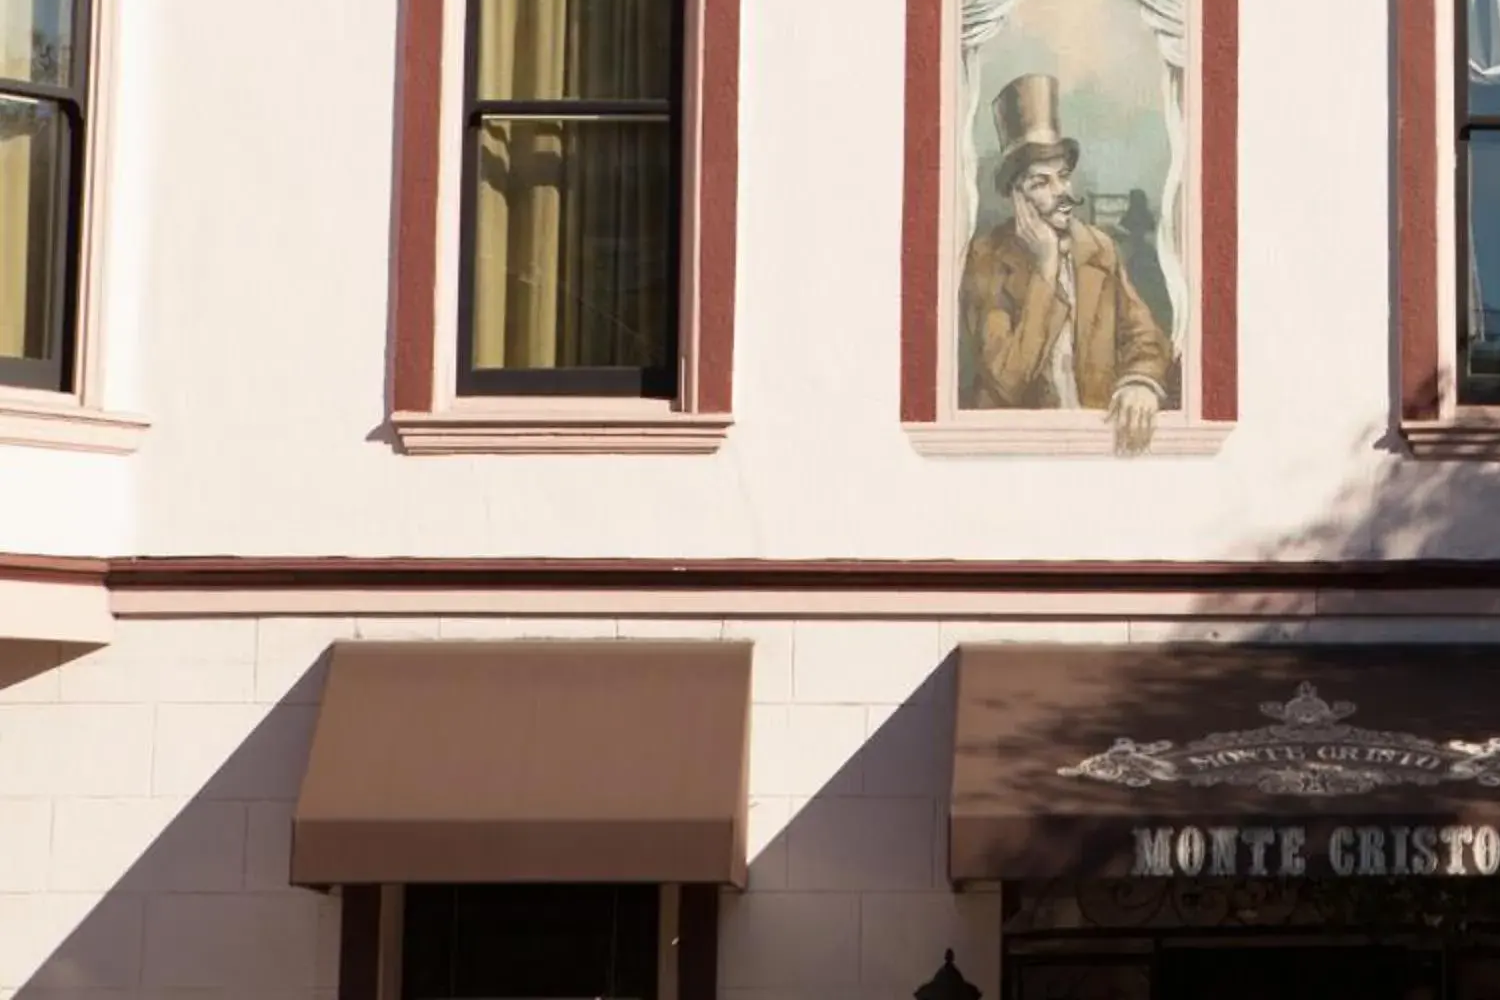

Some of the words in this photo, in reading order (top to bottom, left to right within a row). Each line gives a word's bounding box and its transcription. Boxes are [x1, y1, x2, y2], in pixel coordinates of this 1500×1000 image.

[1189, 746, 1306, 769] MONTE
[1317, 746, 1440, 769] CRISTO
[1131, 825, 1306, 877] MONTE
